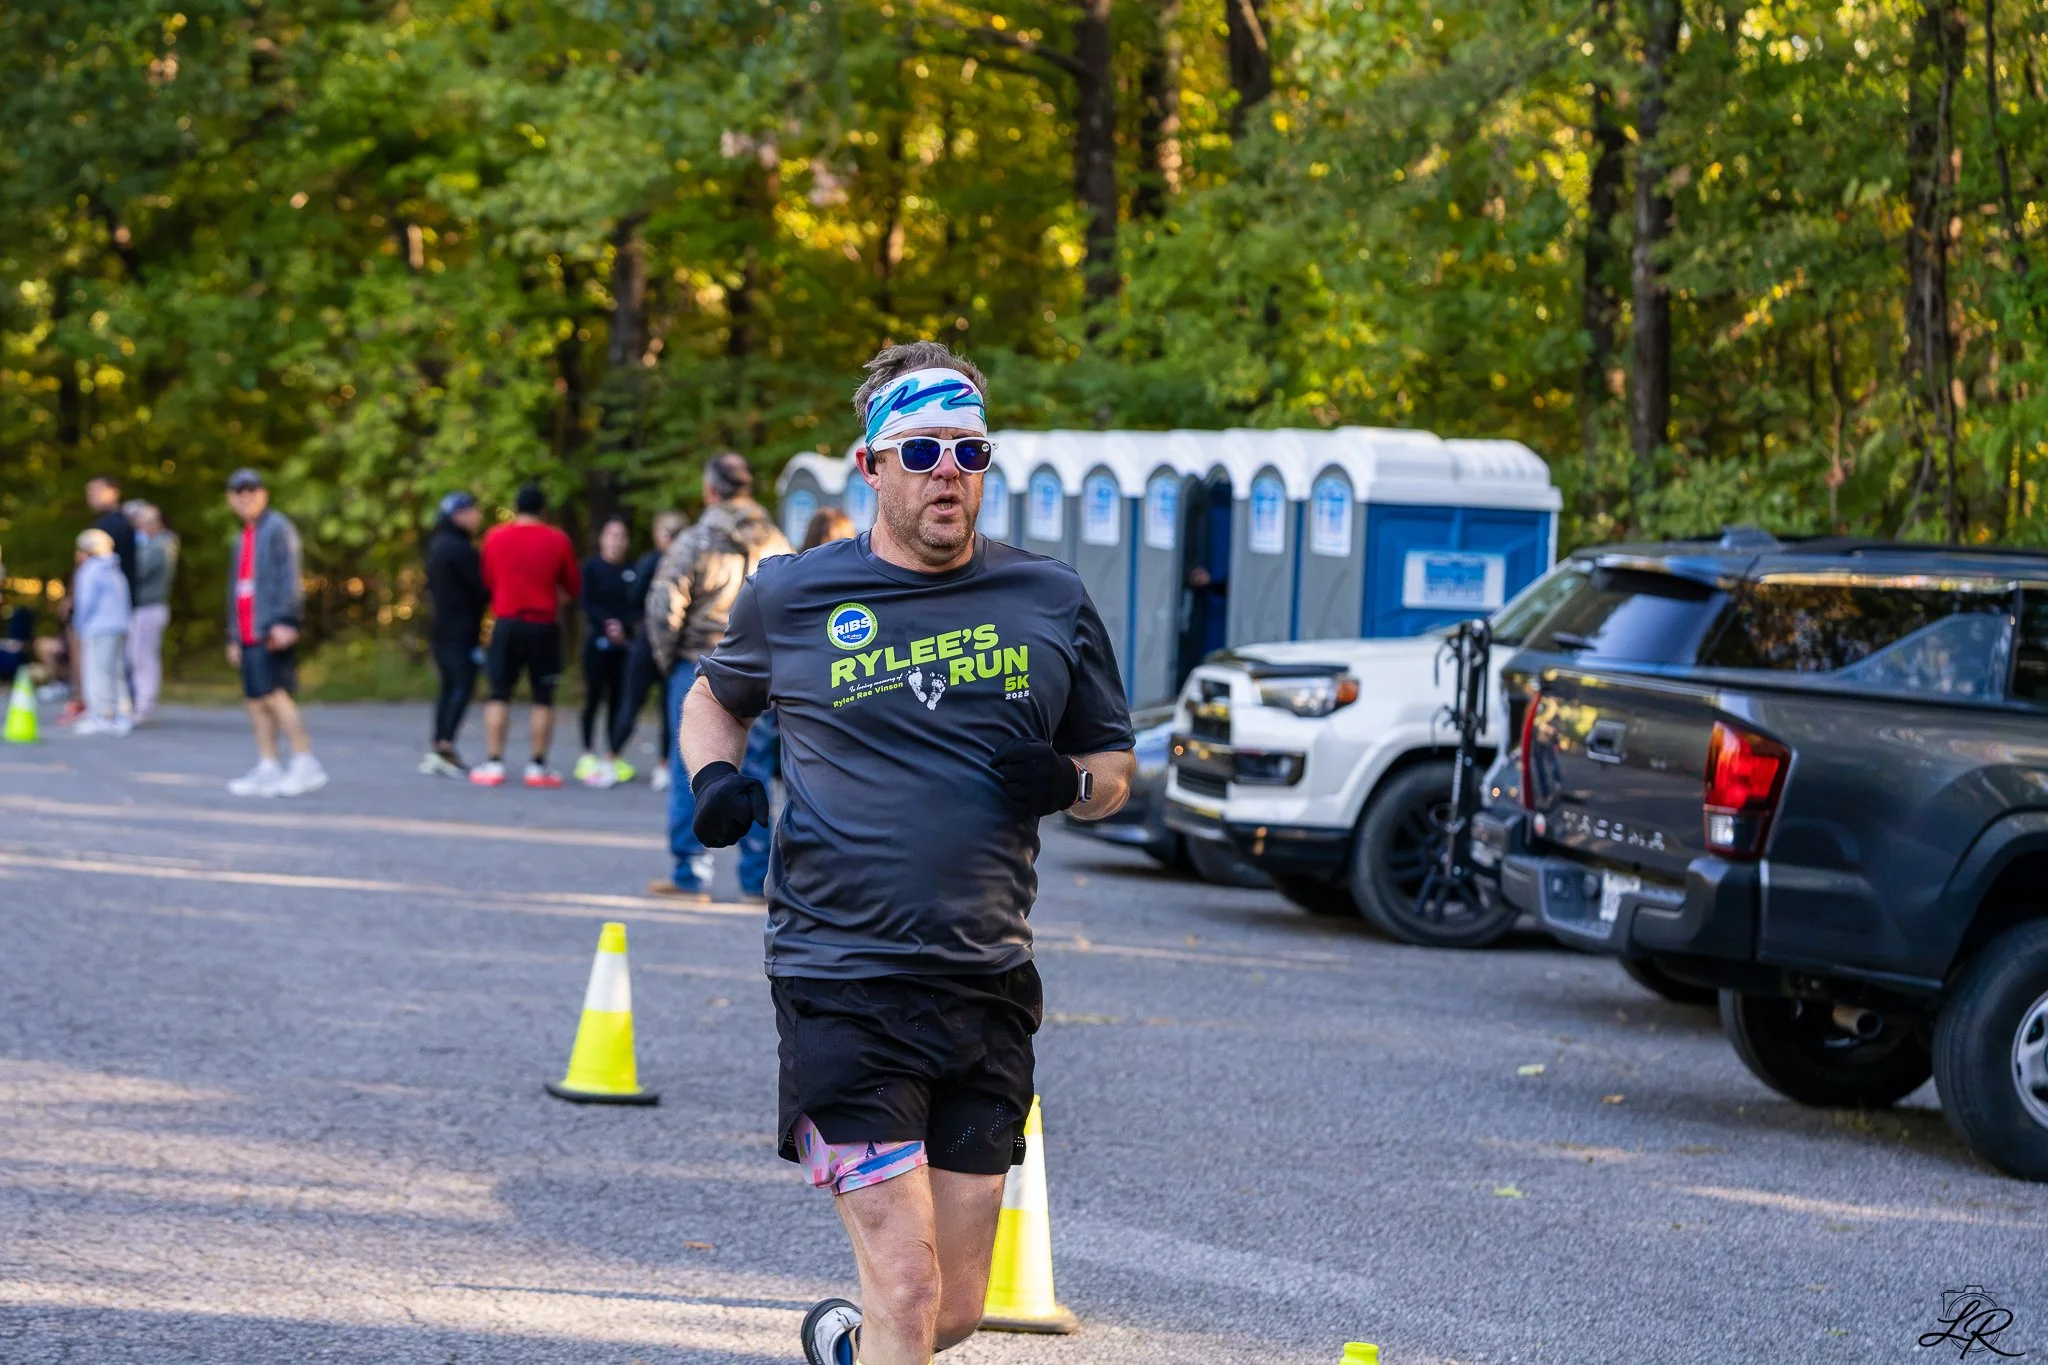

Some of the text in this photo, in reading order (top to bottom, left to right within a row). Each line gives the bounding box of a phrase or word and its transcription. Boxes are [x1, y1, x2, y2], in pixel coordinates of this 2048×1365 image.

[833, 616, 871, 637] RIBS
[831, 623, 999, 688] RYLEE'S
[949, 645, 1028, 686] RUN
[856, 683, 873, 691] loving
[874, 677, 896, 686] memory
[896, 673, 903, 681] of
[1004, 674, 1030, 692] 5K
[833, 682, 904, 708] Rylee Rae Vinson
[1005, 690, 1030, 700] 2025
